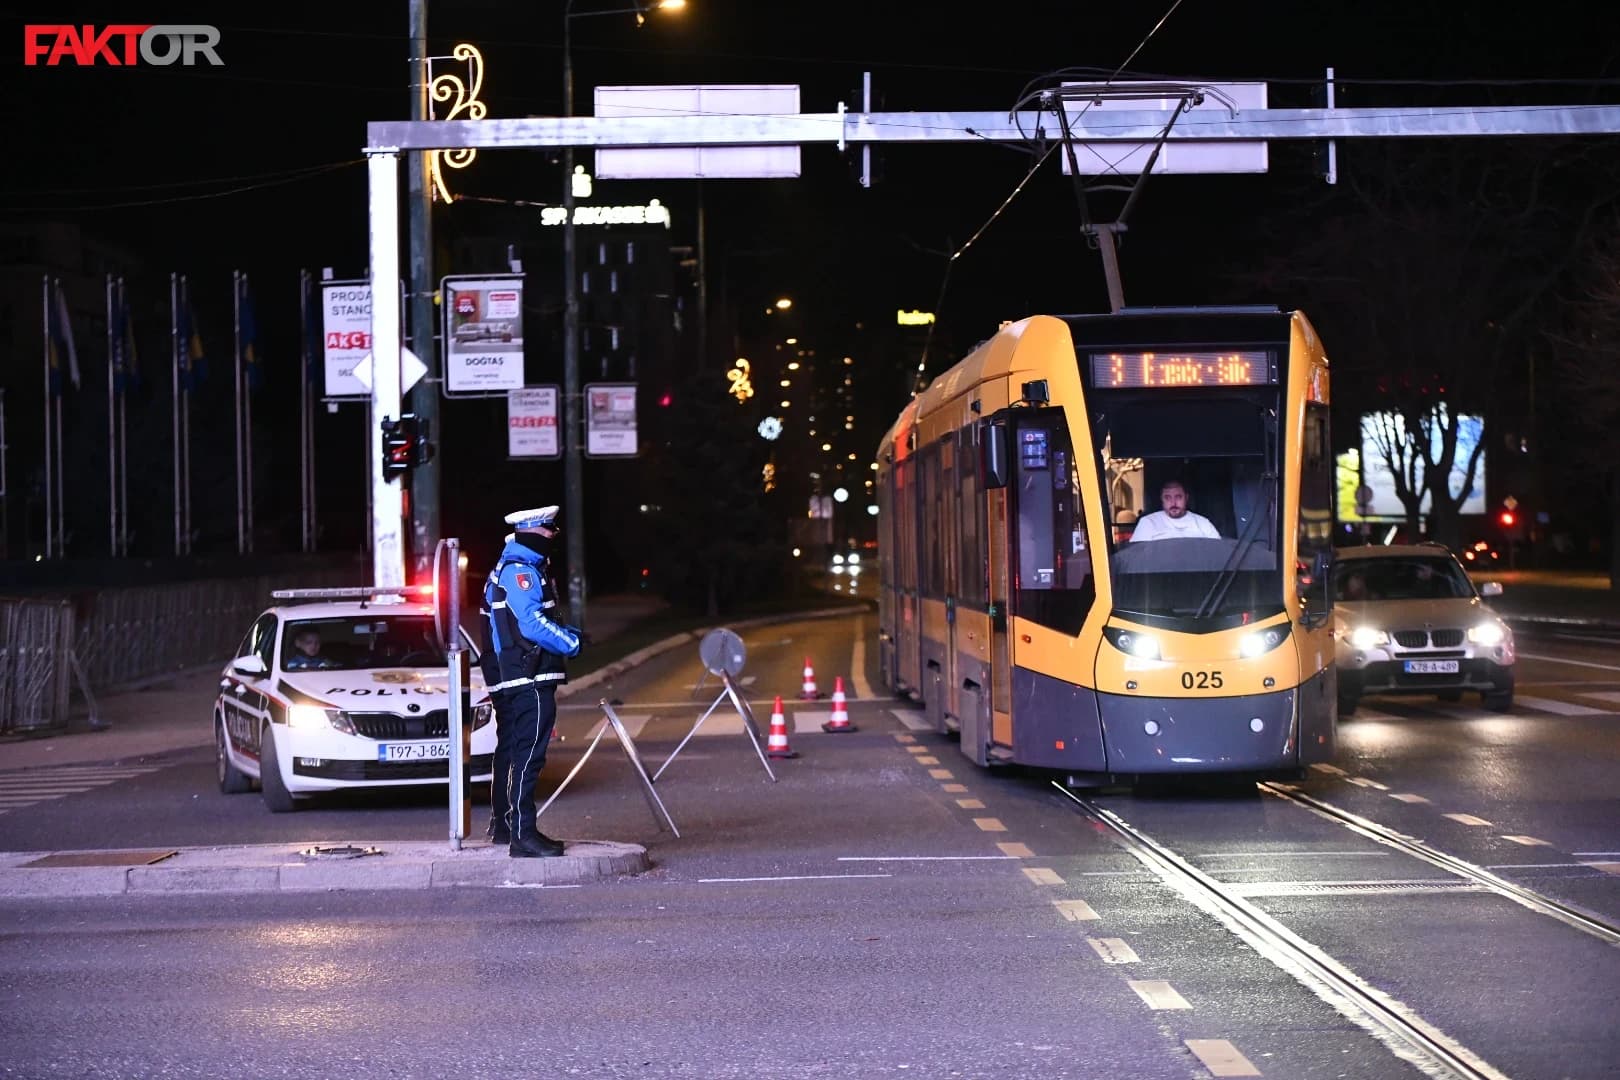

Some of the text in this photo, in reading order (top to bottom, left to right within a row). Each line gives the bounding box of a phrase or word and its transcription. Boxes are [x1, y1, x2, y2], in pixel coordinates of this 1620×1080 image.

[541, 206, 646, 225] SPRKASSE
[331, 291, 372, 301] PRODA
[332, 304, 372, 315] STANO
[328, 333, 372, 348] AKCI
[1181, 671, 1223, 689] 025
[326, 687, 448, 696] POLICI
